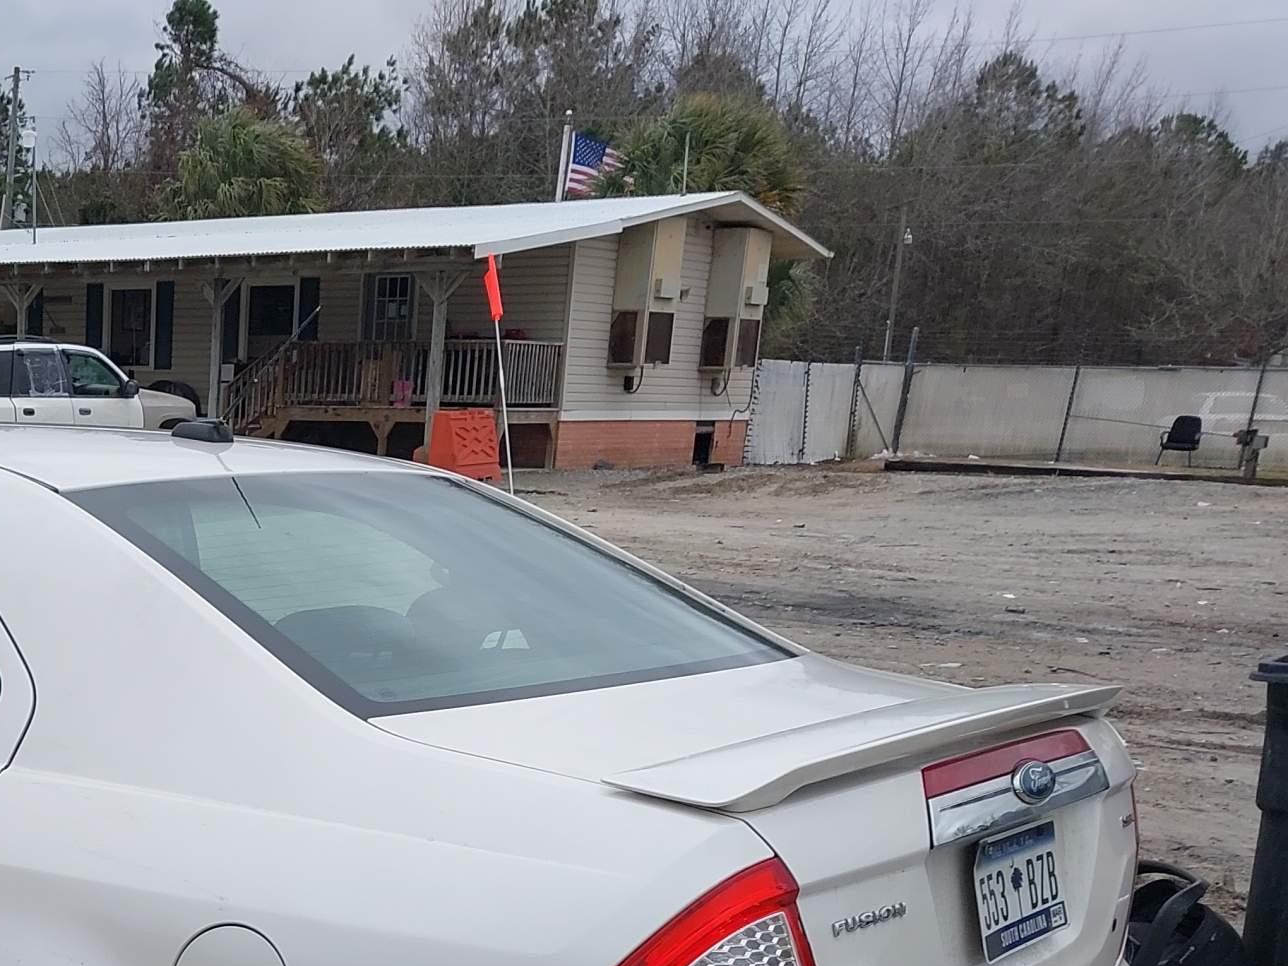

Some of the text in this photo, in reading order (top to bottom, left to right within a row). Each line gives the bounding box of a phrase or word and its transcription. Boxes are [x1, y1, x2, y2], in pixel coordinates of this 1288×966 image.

[979, 851, 1059, 930] 553 BZB
[832, 902, 906, 938] FUSION
